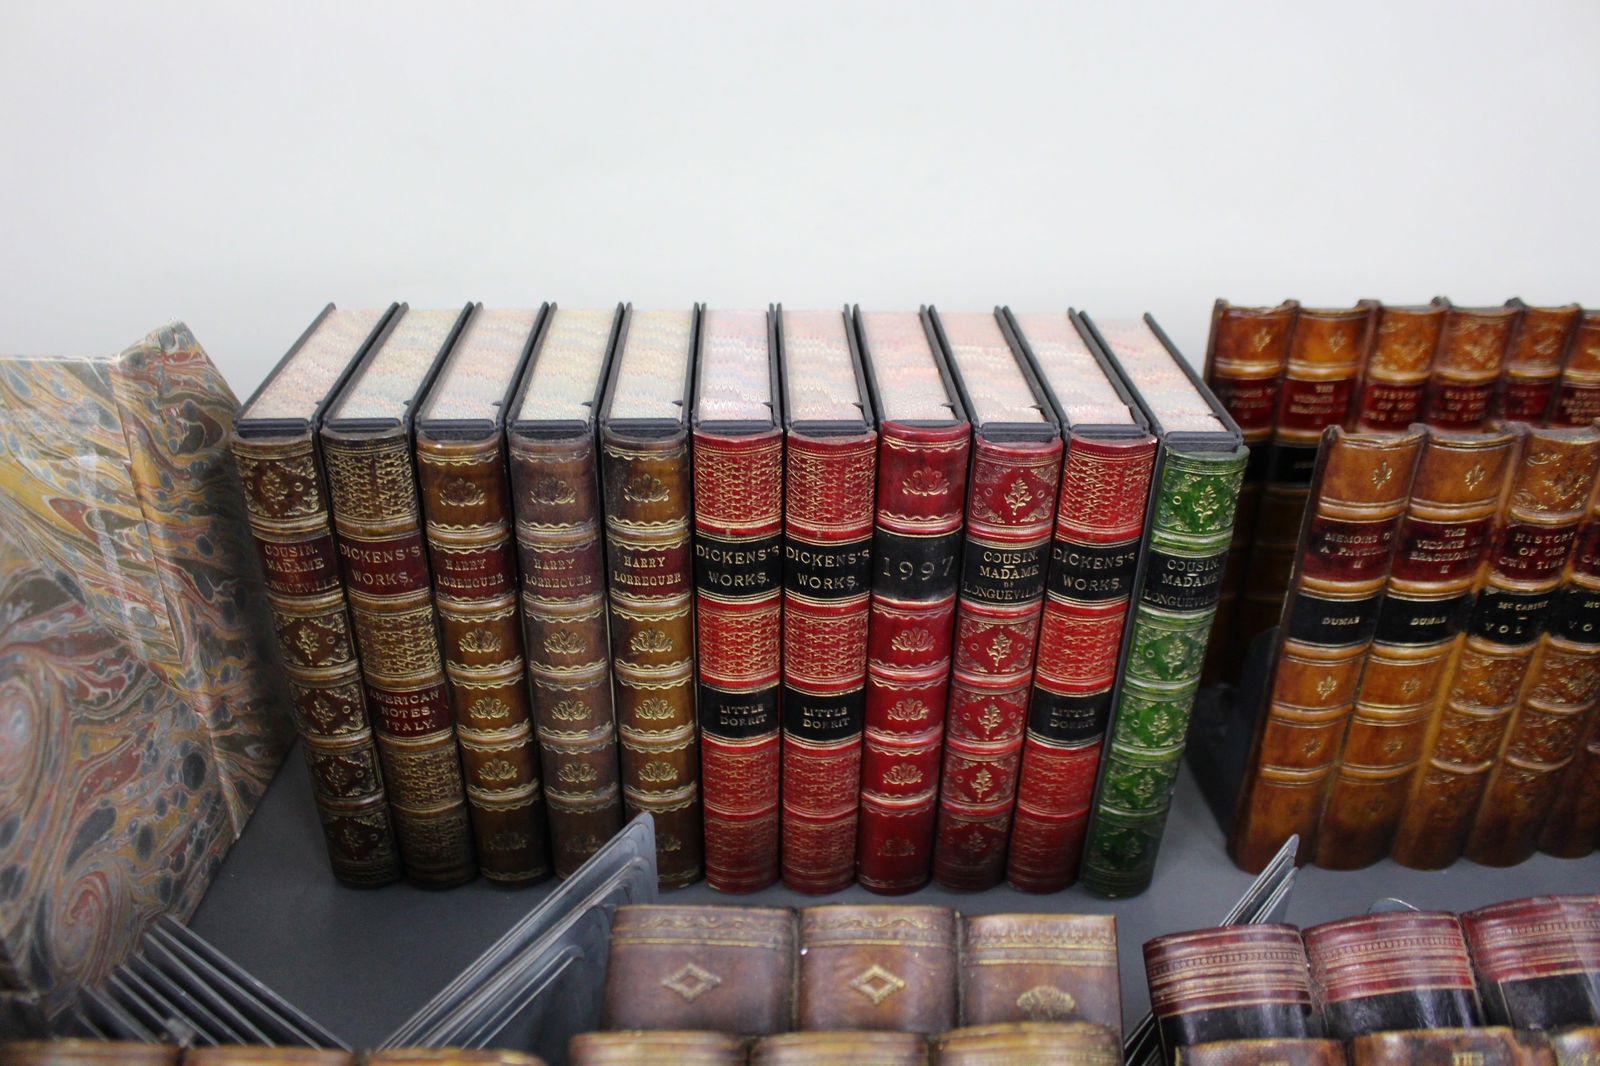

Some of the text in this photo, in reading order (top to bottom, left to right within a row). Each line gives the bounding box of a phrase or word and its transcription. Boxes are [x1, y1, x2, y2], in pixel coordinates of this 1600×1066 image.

[339, 543, 421, 564] DICKENS'S
[695, 544, 780, 565] DICKENS'S
[786, 546, 870, 568] DICKENS'S
[983, 550, 1039, 565] COUSIN.
[1053, 547, 1135, 570] DICKENS'S
[265, 558, 325, 573] MADAME
[533, 557, 576, 570] HARRY
[623, 555, 666, 569] HARRY
[882, 555, 955, 582] 1997
[352, 568, 414, 586] WORKS.
[708, 570, 770, 587] WORKS.
[980, 564, 1040, 580] MADAME
[719, 703, 764, 715] LITTLE
[803, 706, 848, 718] LITTLE
